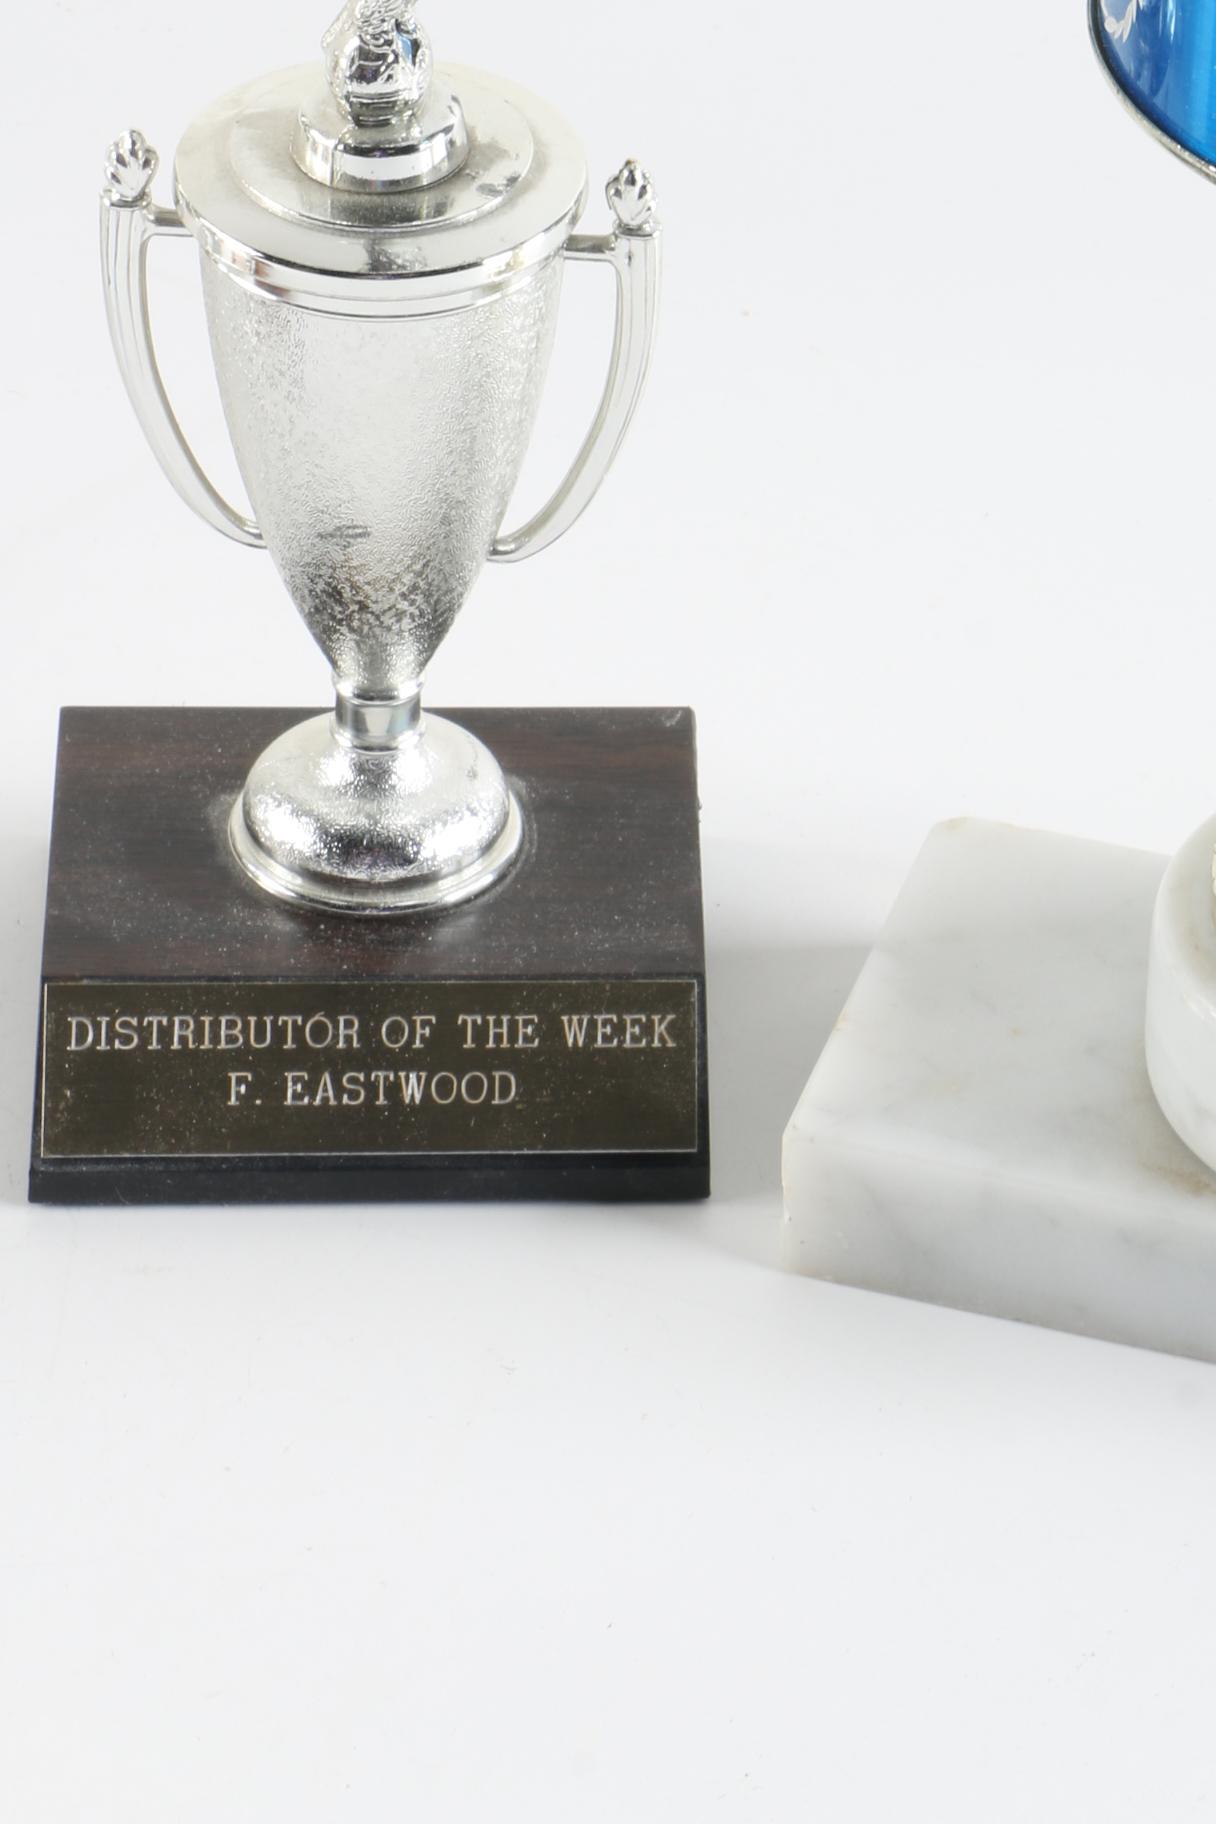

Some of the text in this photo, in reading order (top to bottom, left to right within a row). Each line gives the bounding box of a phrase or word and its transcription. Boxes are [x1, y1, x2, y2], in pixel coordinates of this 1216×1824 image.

[66, 1013, 678, 1051] DISTRIBUTOR OF THE WEEK
[227, 1070, 517, 1106] F. EASTWOOD
